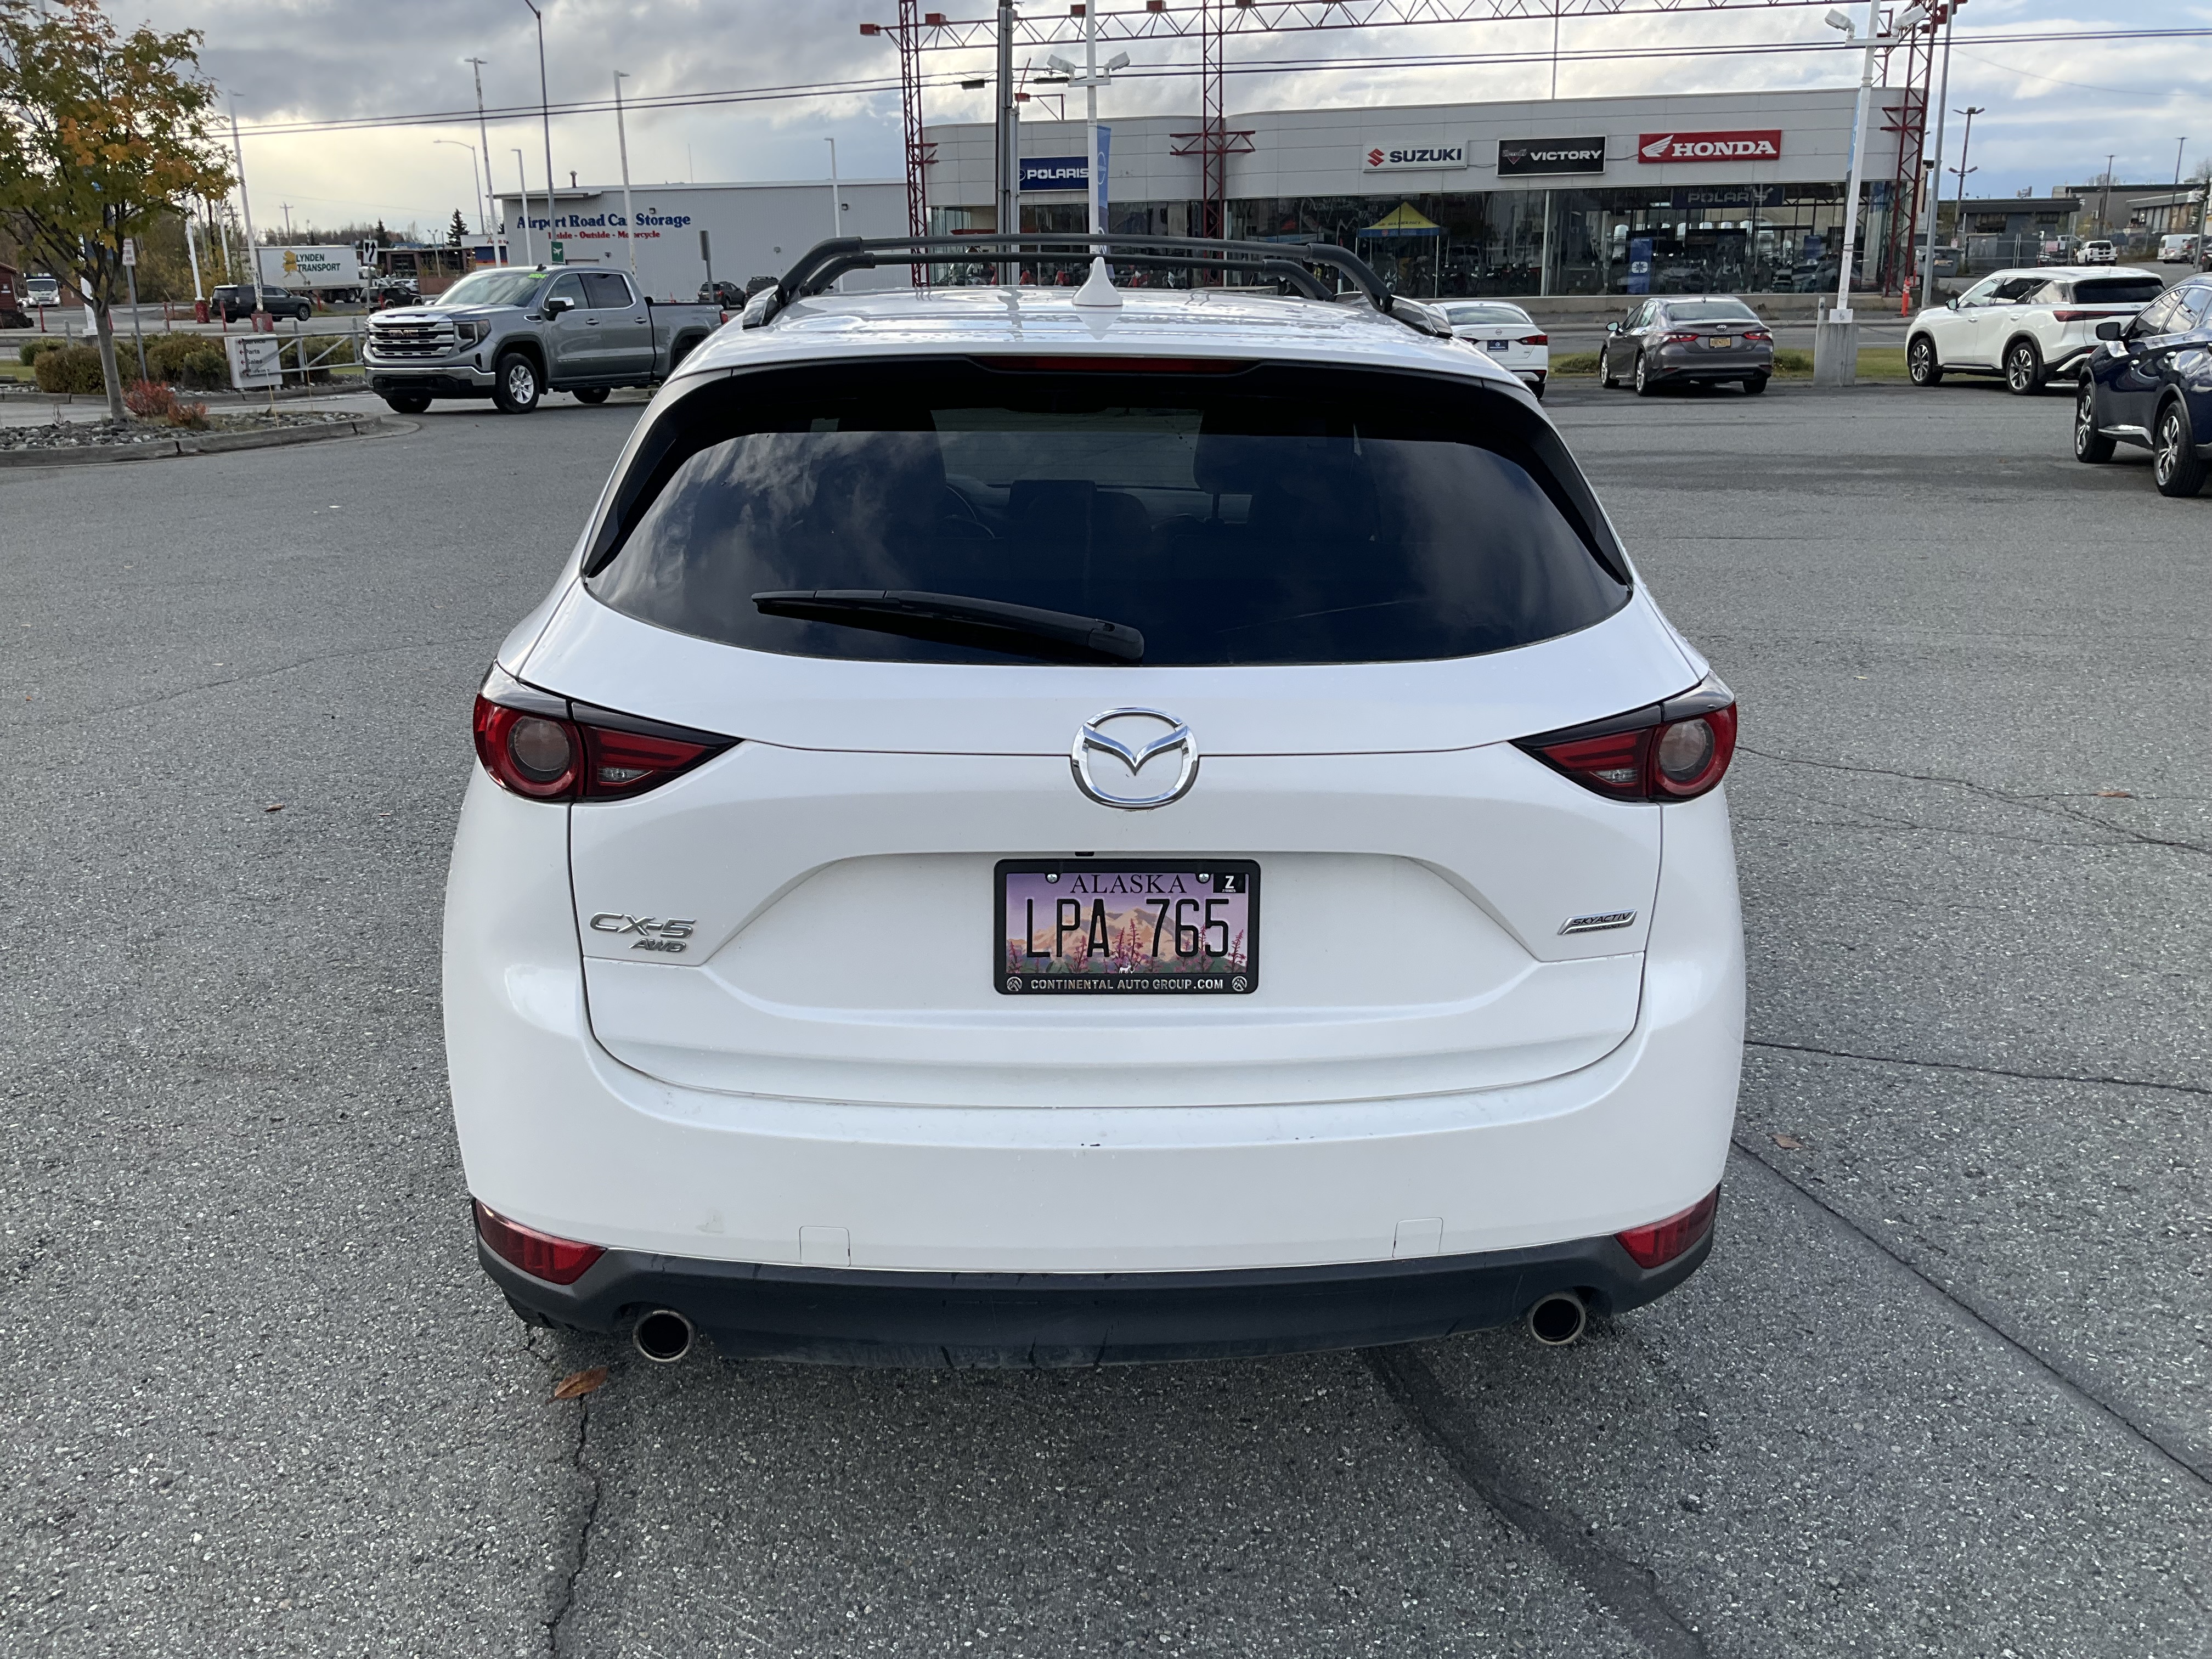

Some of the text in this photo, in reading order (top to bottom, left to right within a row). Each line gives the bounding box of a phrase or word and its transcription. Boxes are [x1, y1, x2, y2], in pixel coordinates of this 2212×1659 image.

[1672, 140, 1777, 156] HONDA
[1389, 148, 1462, 163] SUZUKI
[1530, 150, 1602, 161] VICTORY
[1027, 168, 1089, 179] POLARIS
[568, 213, 606, 227] Road
[608, 213, 630, 227] Ca
[635, 212, 691, 228] Storage
[548, 232, 573, 240] Iside
[579, 230, 611, 239] Outside
[617, 230, 661, 240] Moorcycle
[296, 253, 325, 262] LYNDEN
[297, 263, 341, 272] TRANSPORT
[1070, 874, 1187, 894] ALASKA
[1225, 876, 1234, 889] Z
[590, 911, 697, 939] CX-5
[1571, 912, 1631, 926] SKYACTIV
[1026, 898, 1229, 958] LPA 765
[629, 938, 687, 953] AWD
[1031, 979, 1114, 990] CONTINENTAL
[1119, 979, 1149, 989] AUTO
